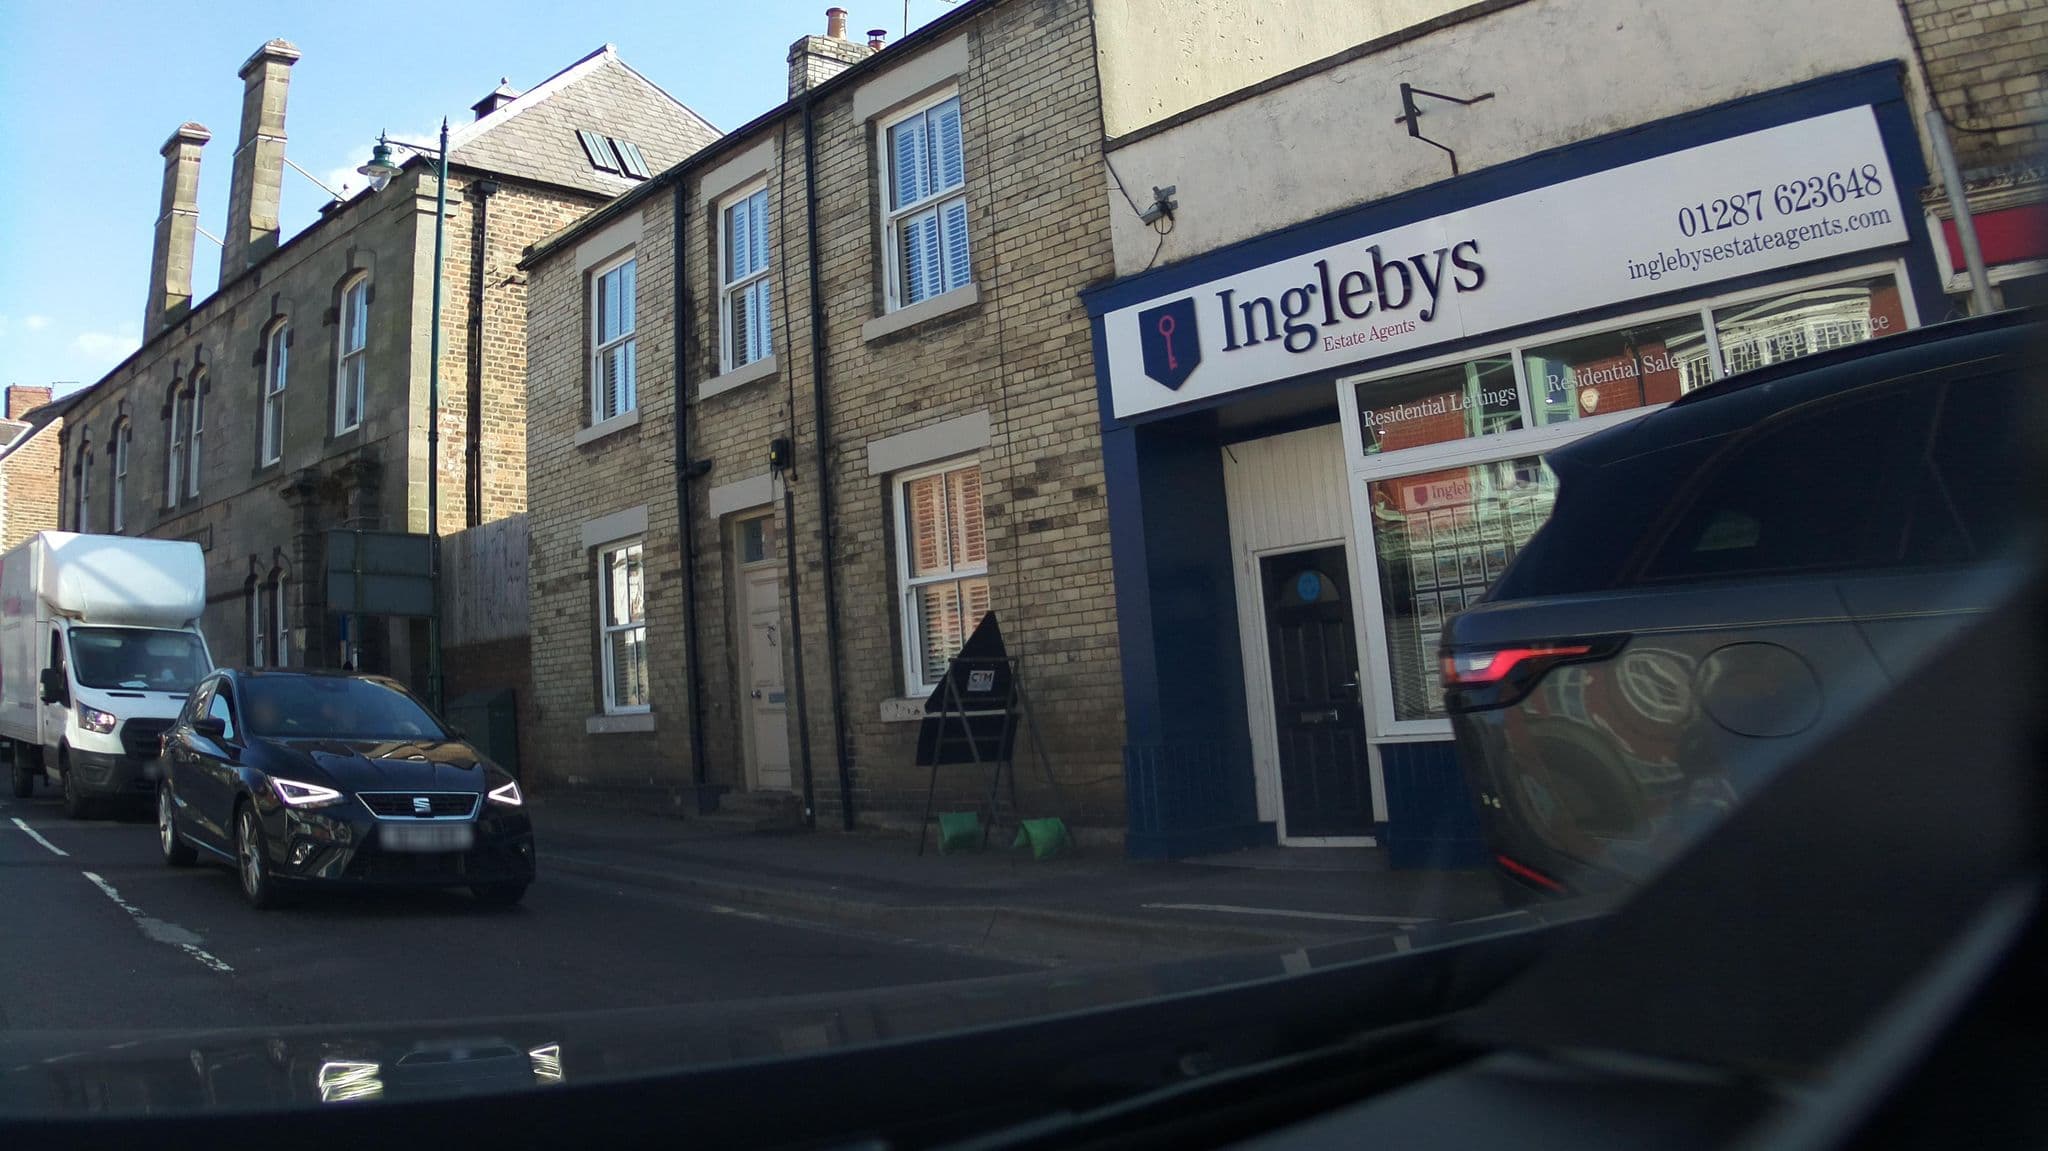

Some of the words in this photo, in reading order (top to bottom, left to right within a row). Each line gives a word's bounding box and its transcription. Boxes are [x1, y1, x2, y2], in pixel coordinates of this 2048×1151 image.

[1678, 190, 1764, 238] 01287
[1774, 164, 1883, 215] 623648
[1627, 207, 1892, 281] inglebysestateagents.com
[1215, 238, 1487, 354] Inglebys
[1323, 331, 1366, 352] Estate
[1368, 318, 1416, 345] Agents
[1547, 358, 1641, 393] Residential
[1363, 396, 1447, 427] Residential
[1450, 387, 1517, 412] Letings
[1431, 479, 1486, 500] Inglebs
